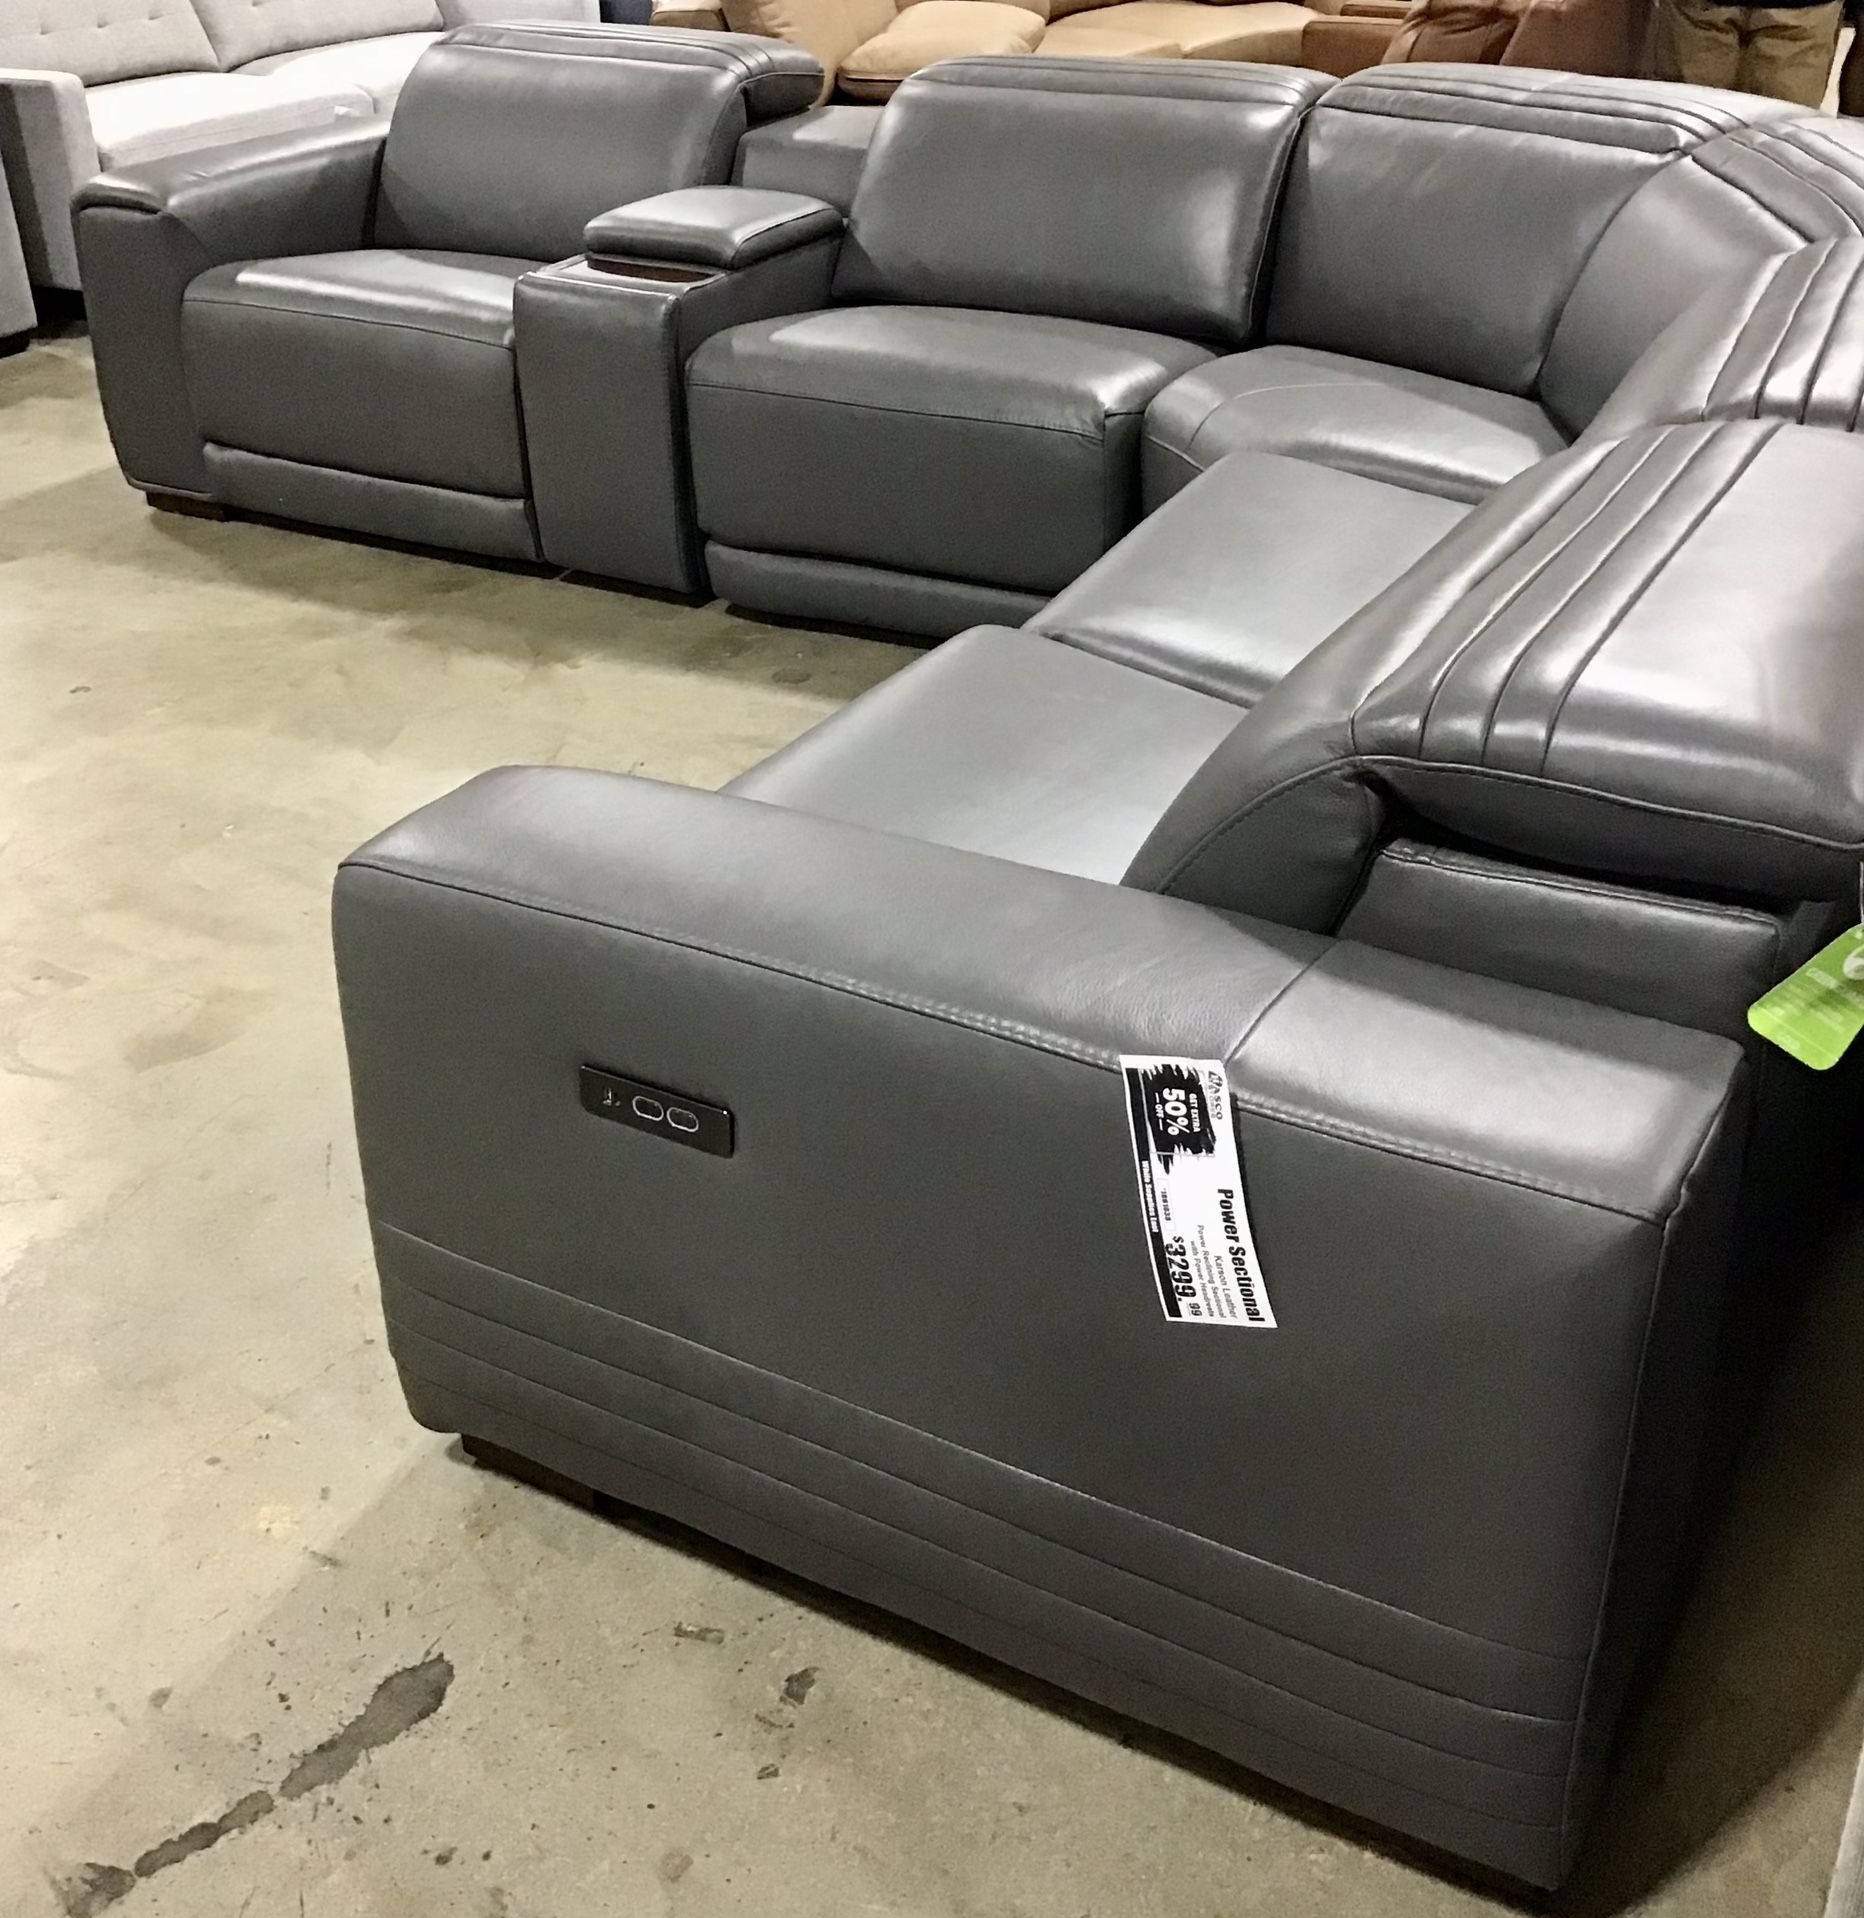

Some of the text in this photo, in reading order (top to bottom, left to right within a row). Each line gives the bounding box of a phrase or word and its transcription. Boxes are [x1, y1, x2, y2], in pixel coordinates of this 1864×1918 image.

[1155, 1104, 1163, 1118] OFF
[1163, 1088, 1190, 1135] 50%
[1189, 1094, 1200, 1132] GET EXTRA
[1141, 1161, 1158, 1232] While Supplies Last
[1190, 1240, 1214, 1317] with Power Headrests
[1197, 1225, 1226, 1318] Power Reclining Sectional
[1214, 1256, 1238, 1319] Karson Leather
[1218, 1189, 1265, 1322] Power Sectional
